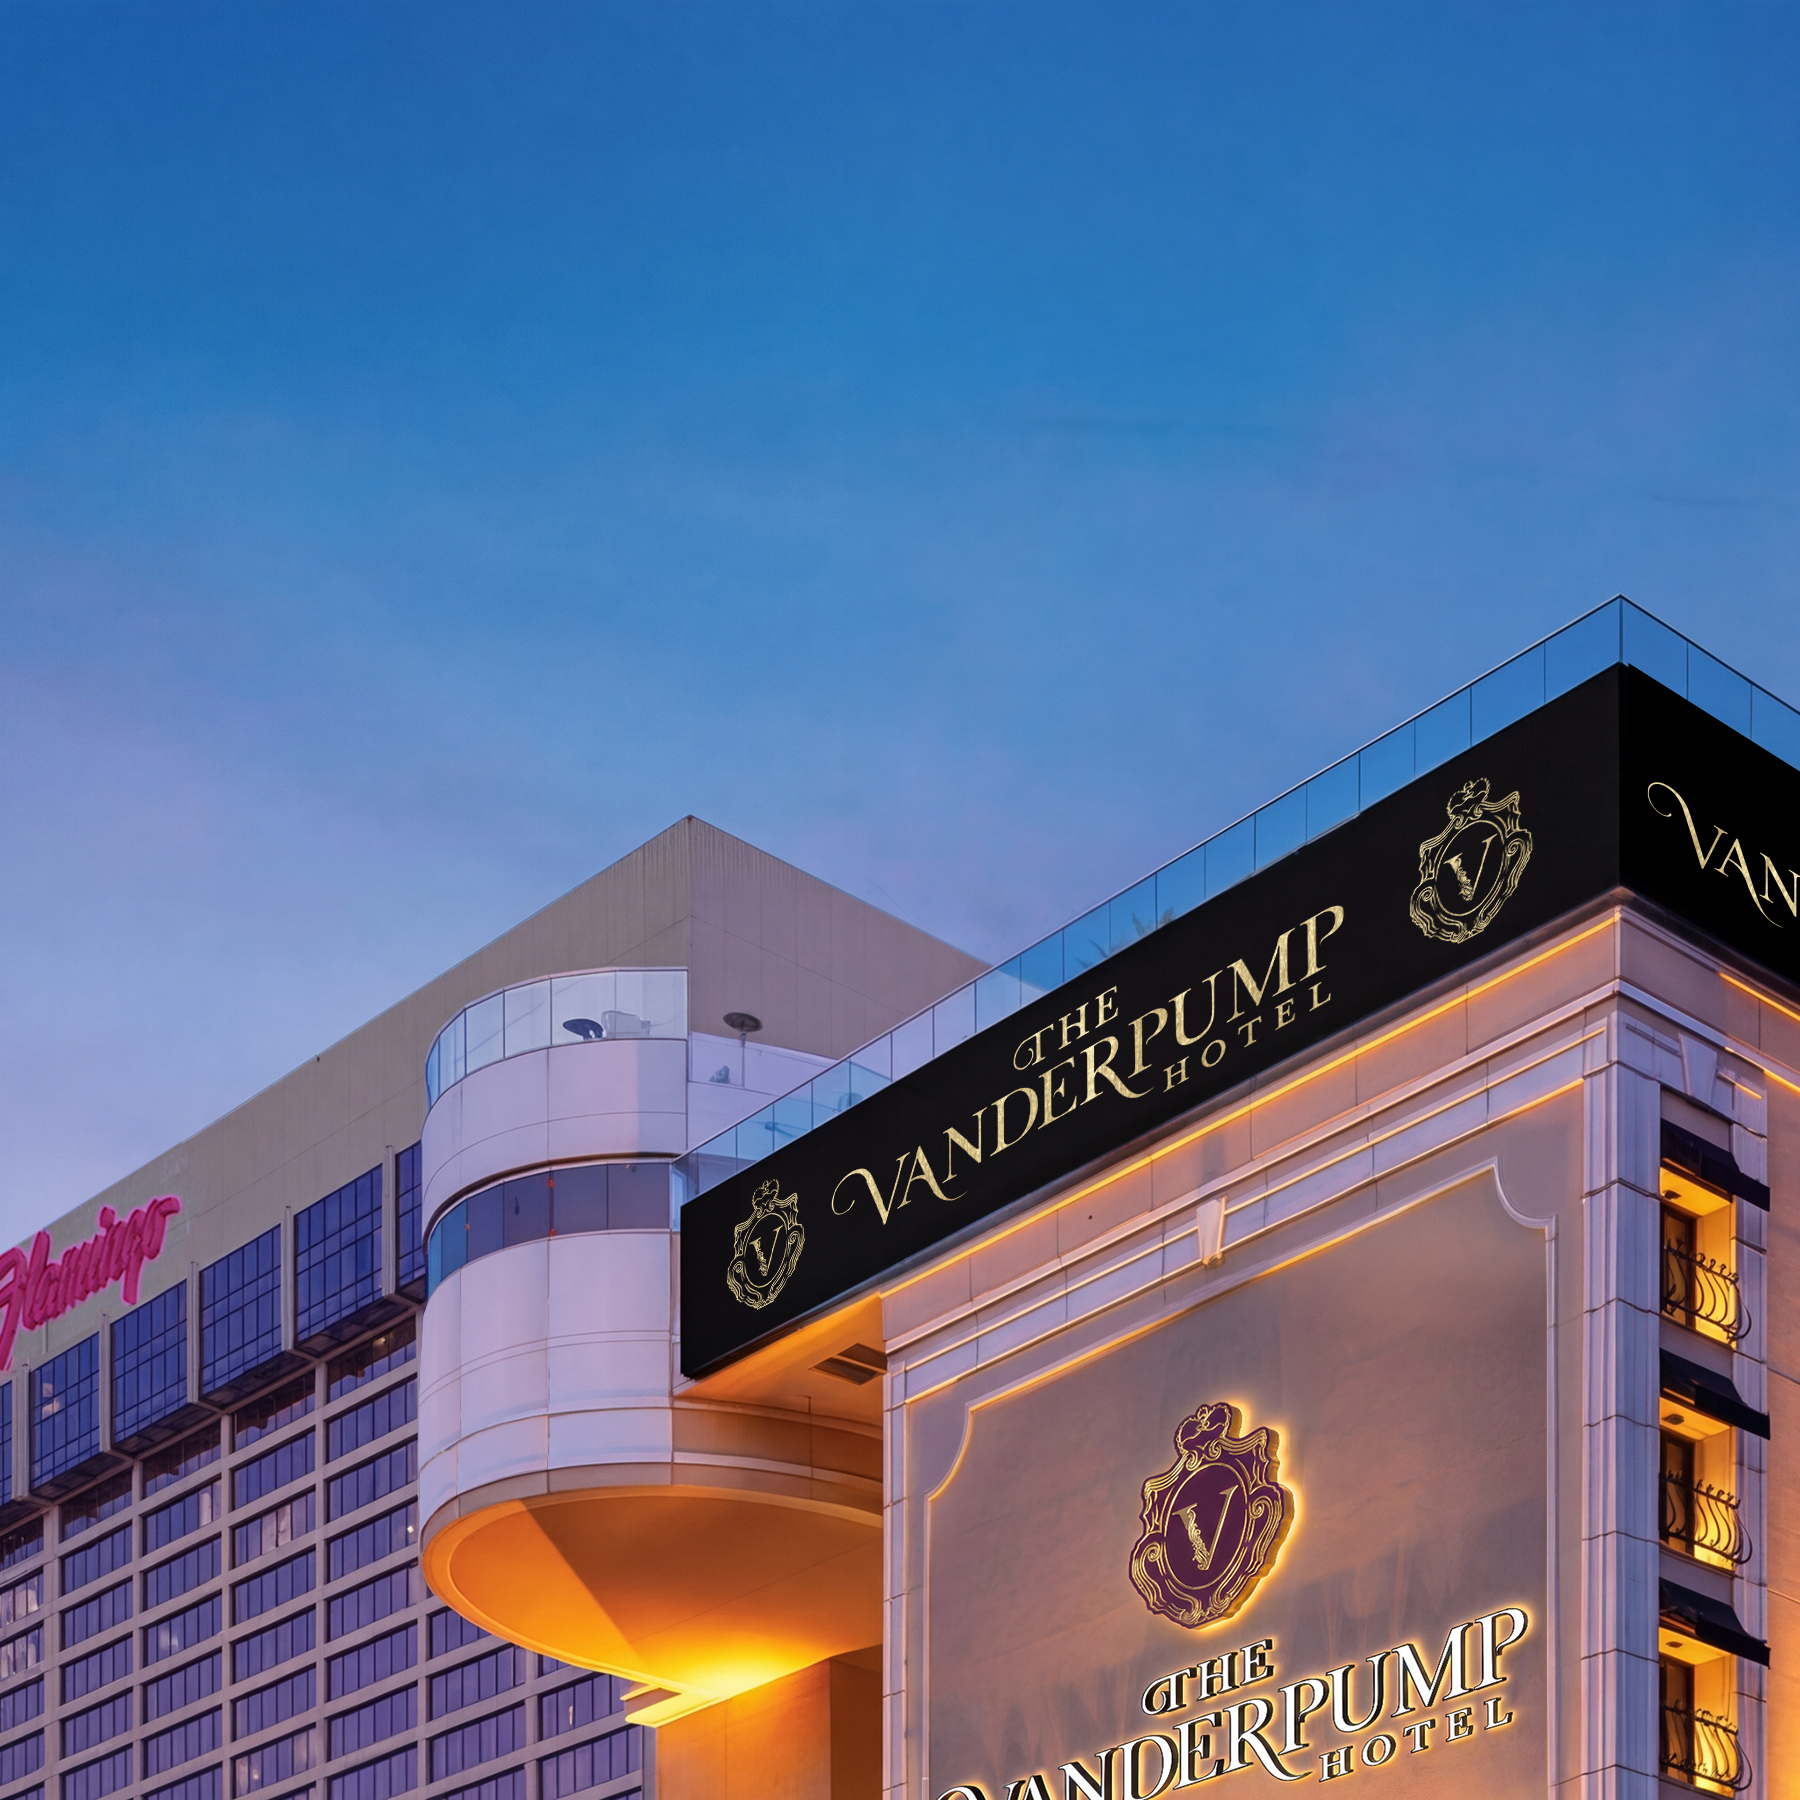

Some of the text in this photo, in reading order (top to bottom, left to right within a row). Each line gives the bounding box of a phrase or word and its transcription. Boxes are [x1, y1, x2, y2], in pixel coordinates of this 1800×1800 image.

[1443, 833, 1498, 902] V
[832, 904, 1344, 1225] VANDERPUMP
[1013, 986, 1119, 1072] THE
[1164, 988, 1331, 1093] HOTEL
[750, 1225, 784, 1276] V
[1173, 1486, 1239, 1571] V
[1141, 1638, 1275, 1716] THE
[1319, 1697, 1513, 1782] HOTEL
